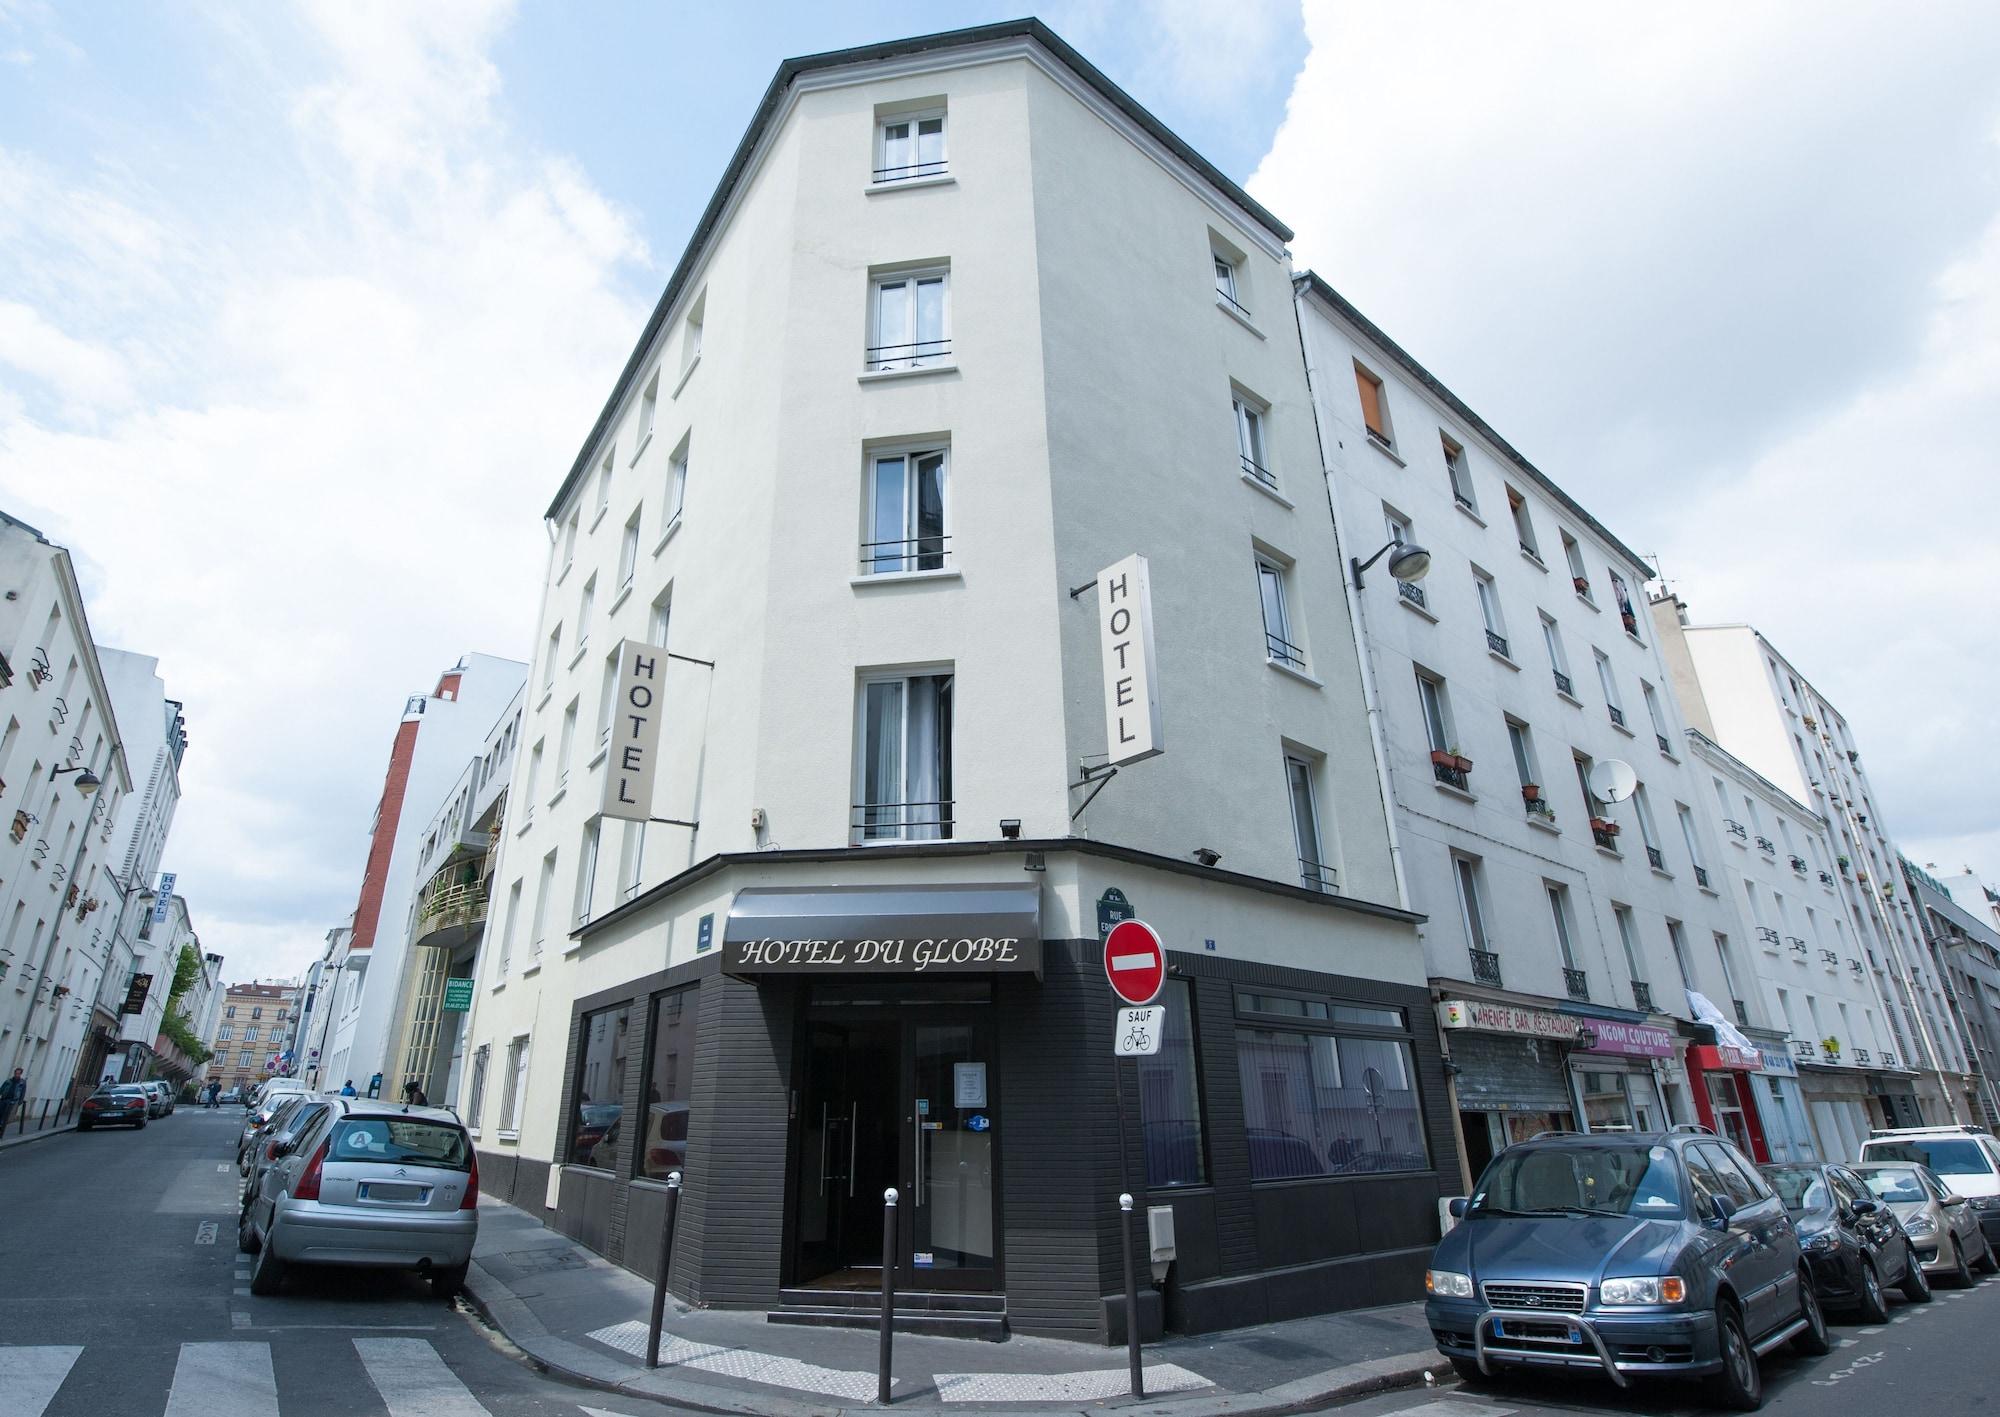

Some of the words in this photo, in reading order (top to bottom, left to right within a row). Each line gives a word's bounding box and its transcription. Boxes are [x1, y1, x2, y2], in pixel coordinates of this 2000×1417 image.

[1109, 572, 1136, 744] HOTEL
[618, 654, 656, 805] HOTEL
[156, 876, 173, 915] HOTEL
[1109, 910, 1122, 921] RUE
[738, 937, 846, 964] HOTEL
[854, 939, 904, 964] DU
[912, 937, 1019, 972] GLOBE
[448, 980, 473, 989] BIDANCE
[1128, 1010, 1152, 1022] SAUF
[1477, 1007, 1512, 1029] AHENFIE
[1514, 1011, 1530, 1031] BAR
[1533, 1014, 1577, 1036] RESTAURANT
[1598, 1023, 1627, 1043] NGOM
[1628, 1028, 1671, 1048] COUTURE
[353, 1133, 367, 1146] A
